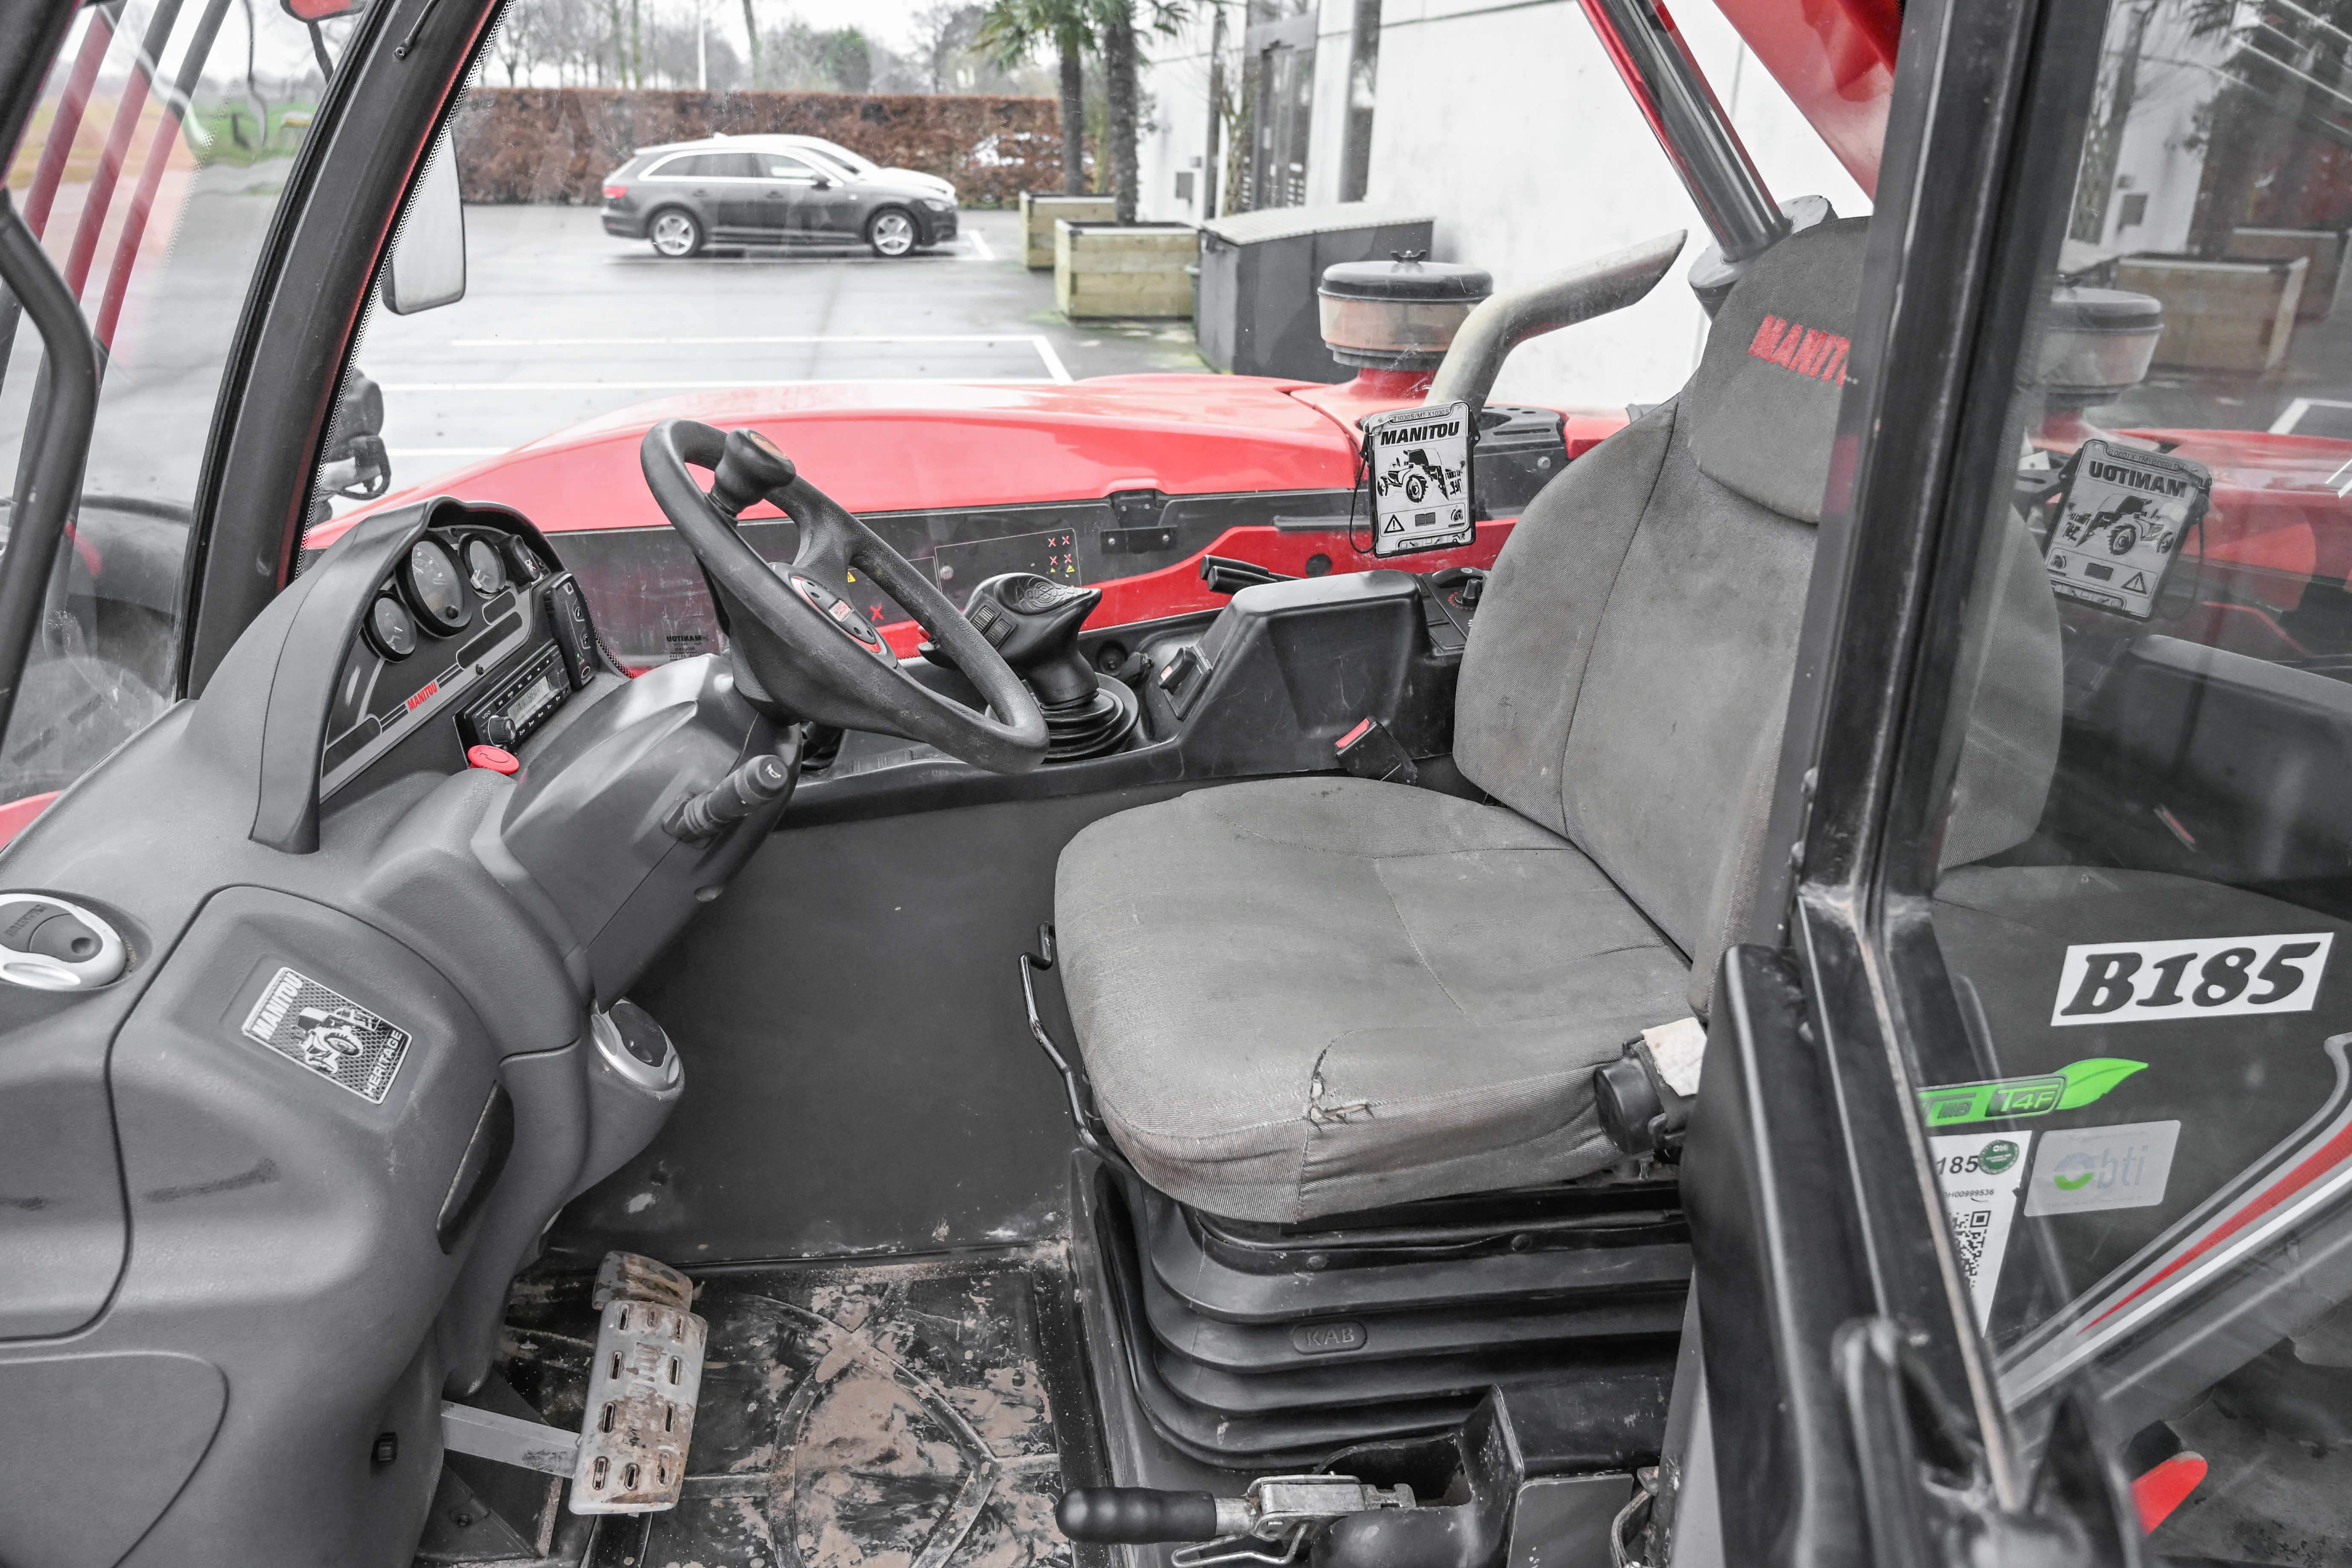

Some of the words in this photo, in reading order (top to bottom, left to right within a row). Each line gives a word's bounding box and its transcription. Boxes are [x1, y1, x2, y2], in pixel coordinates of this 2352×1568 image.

[1380, 421, 1460, 446] MANITOU
[407, 681, 438, 711] MANITOU
[481, 710, 491, 720] VDO
[2060, 941, 2320, 1016] B185
[252, 972, 303, 1040] MANITOU
[364, 1029, 403, 1096] HERITAGE
[1305, 1327, 1355, 1346] KAB
